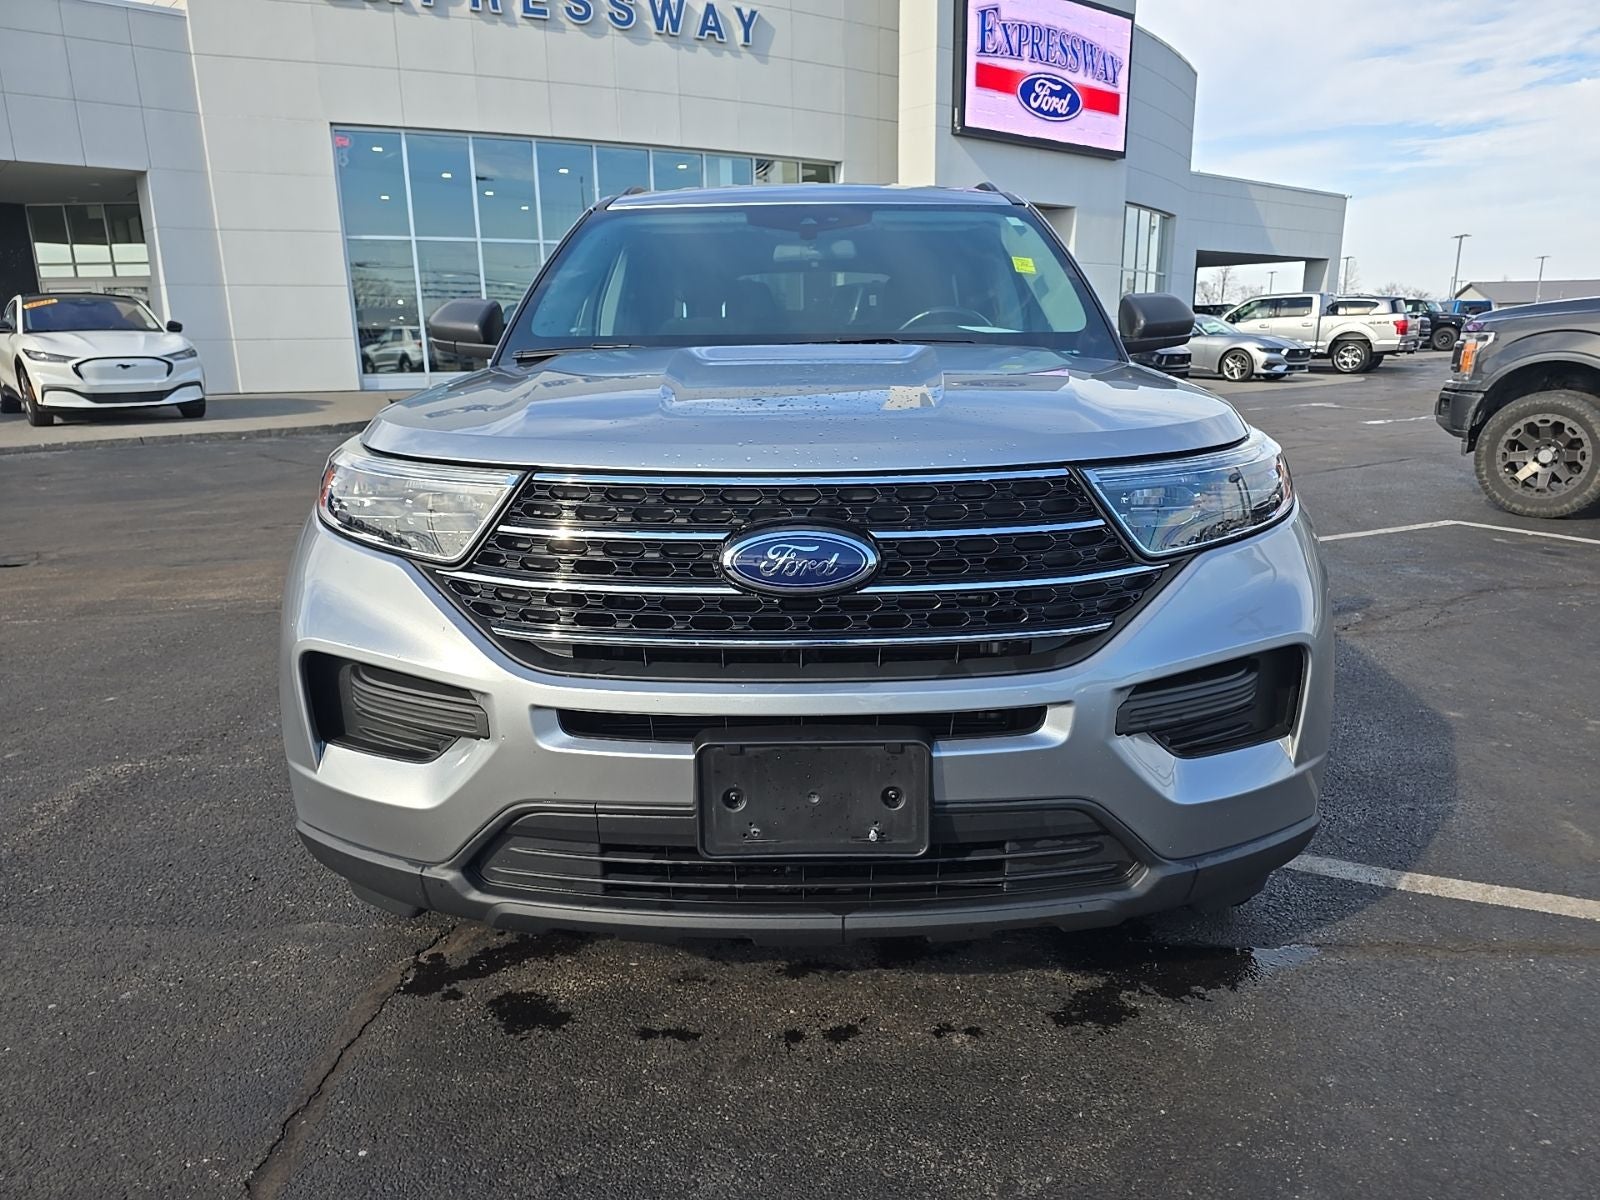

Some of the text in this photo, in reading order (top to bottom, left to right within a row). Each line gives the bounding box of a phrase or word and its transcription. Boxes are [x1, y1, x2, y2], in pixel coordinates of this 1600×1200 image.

[977, 7, 1121, 86] EXPRESSWAY
[1029, 79, 1071, 115] Ford
[759, 543, 840, 577] Ford
